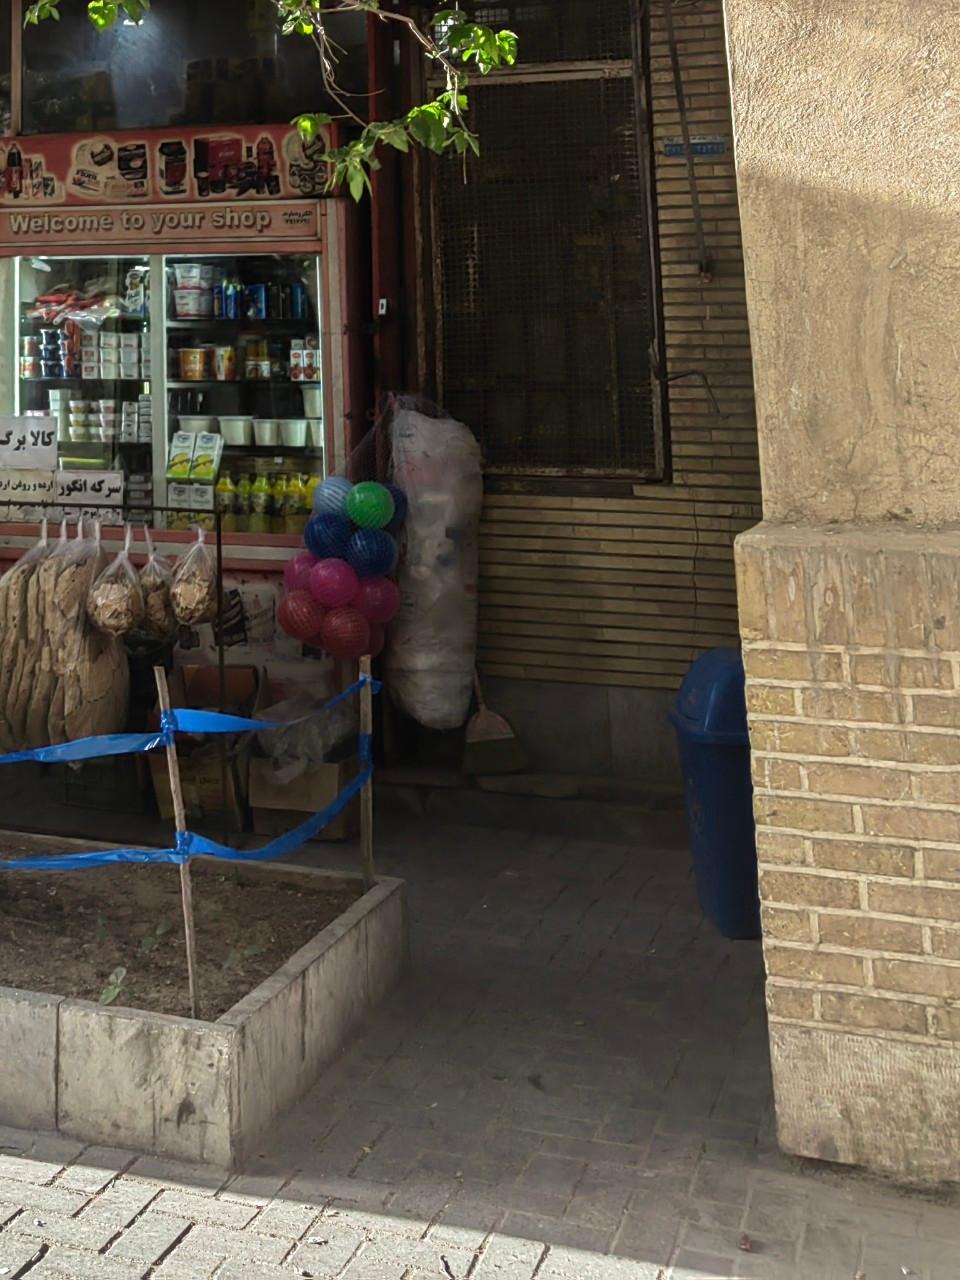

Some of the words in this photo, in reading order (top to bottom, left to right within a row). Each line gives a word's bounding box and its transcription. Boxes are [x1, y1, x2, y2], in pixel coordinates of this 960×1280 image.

[9, 211, 113, 234] Welcome
[120, 211, 144, 231] to
[151, 212, 205, 235] your
[212, 207, 271, 234] shop
[30, 430, 55, 446] کالا
